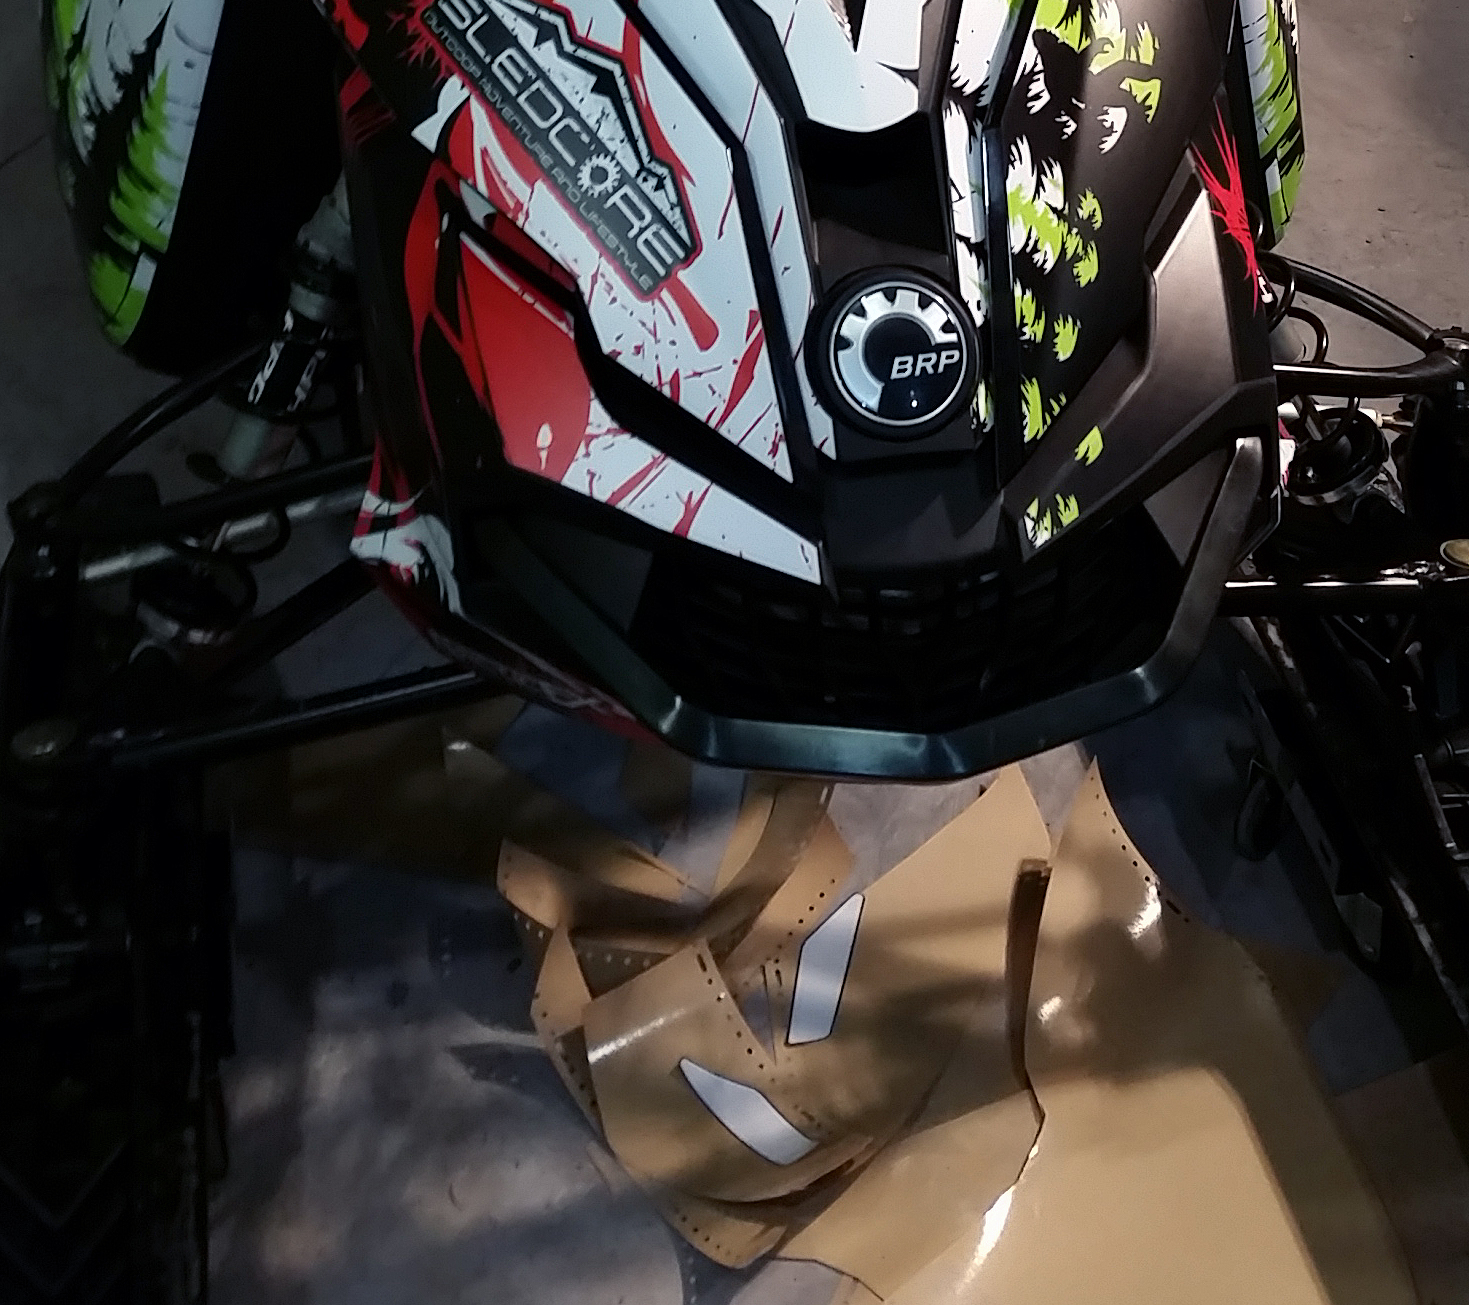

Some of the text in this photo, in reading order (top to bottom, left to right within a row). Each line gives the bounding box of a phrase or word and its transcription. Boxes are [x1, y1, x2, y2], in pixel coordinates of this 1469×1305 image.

[478, 77, 552, 170] ADVENTURE
[551, 167, 582, 203] AND
[579, 201, 655, 291] LIFESTYLE
[890, 349, 960, 380] BRP
